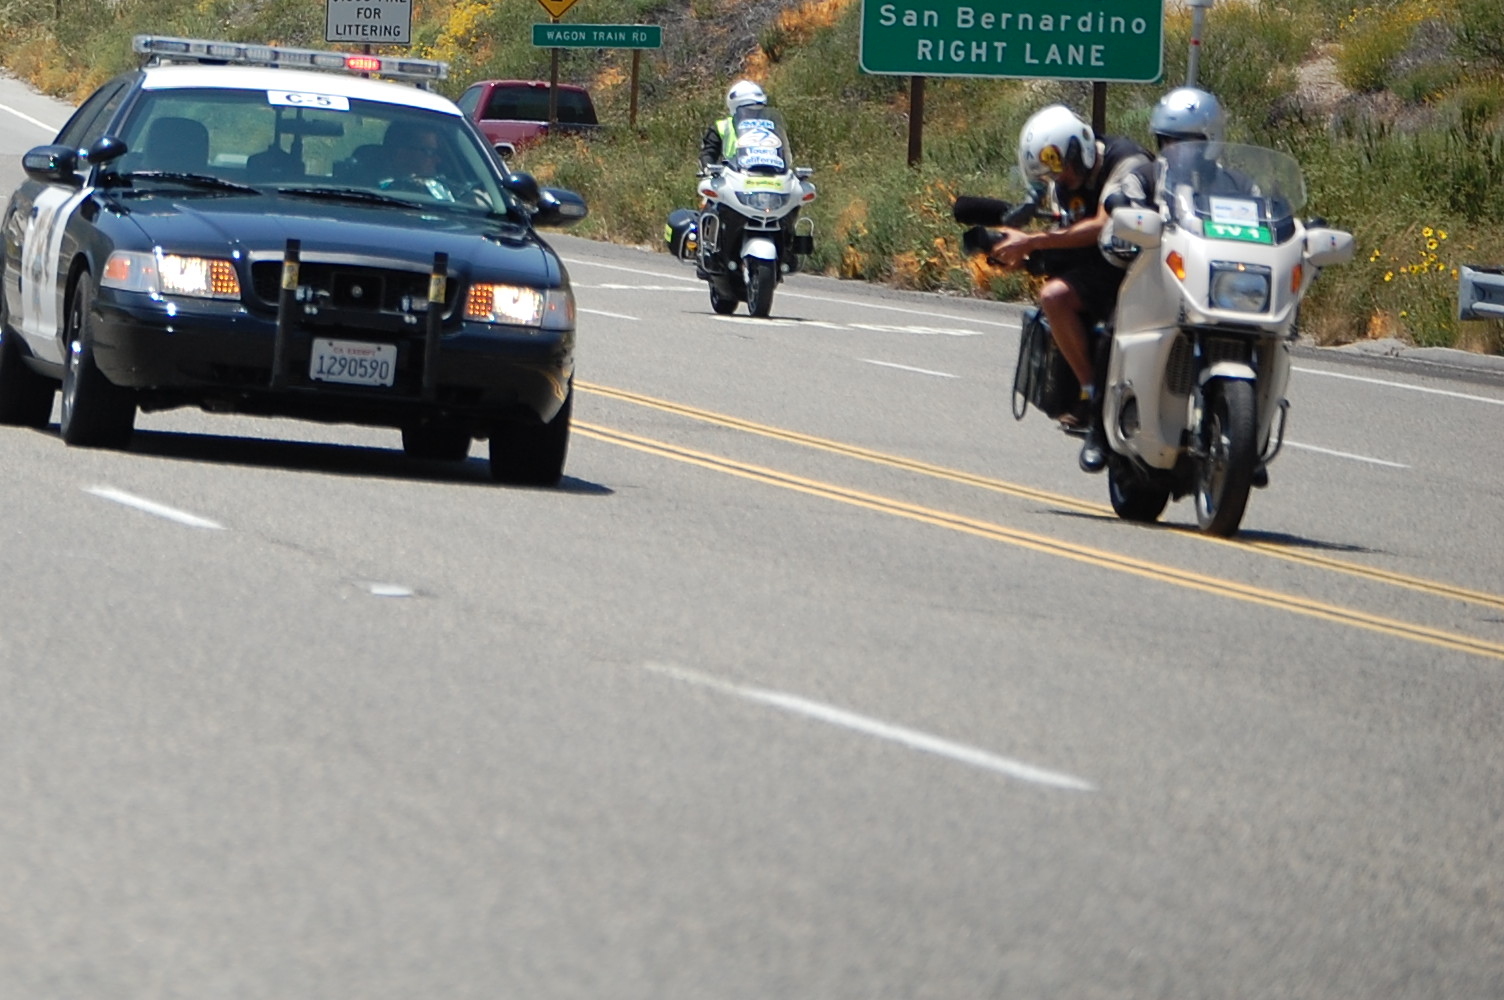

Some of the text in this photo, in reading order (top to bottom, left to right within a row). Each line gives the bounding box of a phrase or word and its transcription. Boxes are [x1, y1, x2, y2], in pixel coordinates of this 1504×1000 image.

[356, 7, 382, 19] FOR
[879, 4, 1147, 35] San Bernardino
[335, 24, 401, 37] LITTERING
[546, 31, 647, 42] WAGON TRAIN RD
[917, 39, 1105, 67] RIGHT LANE
[285, 93, 332, 107] C-5
[1212, 225, 1260, 239] TV 1
[316, 355, 390, 380] 1290590
